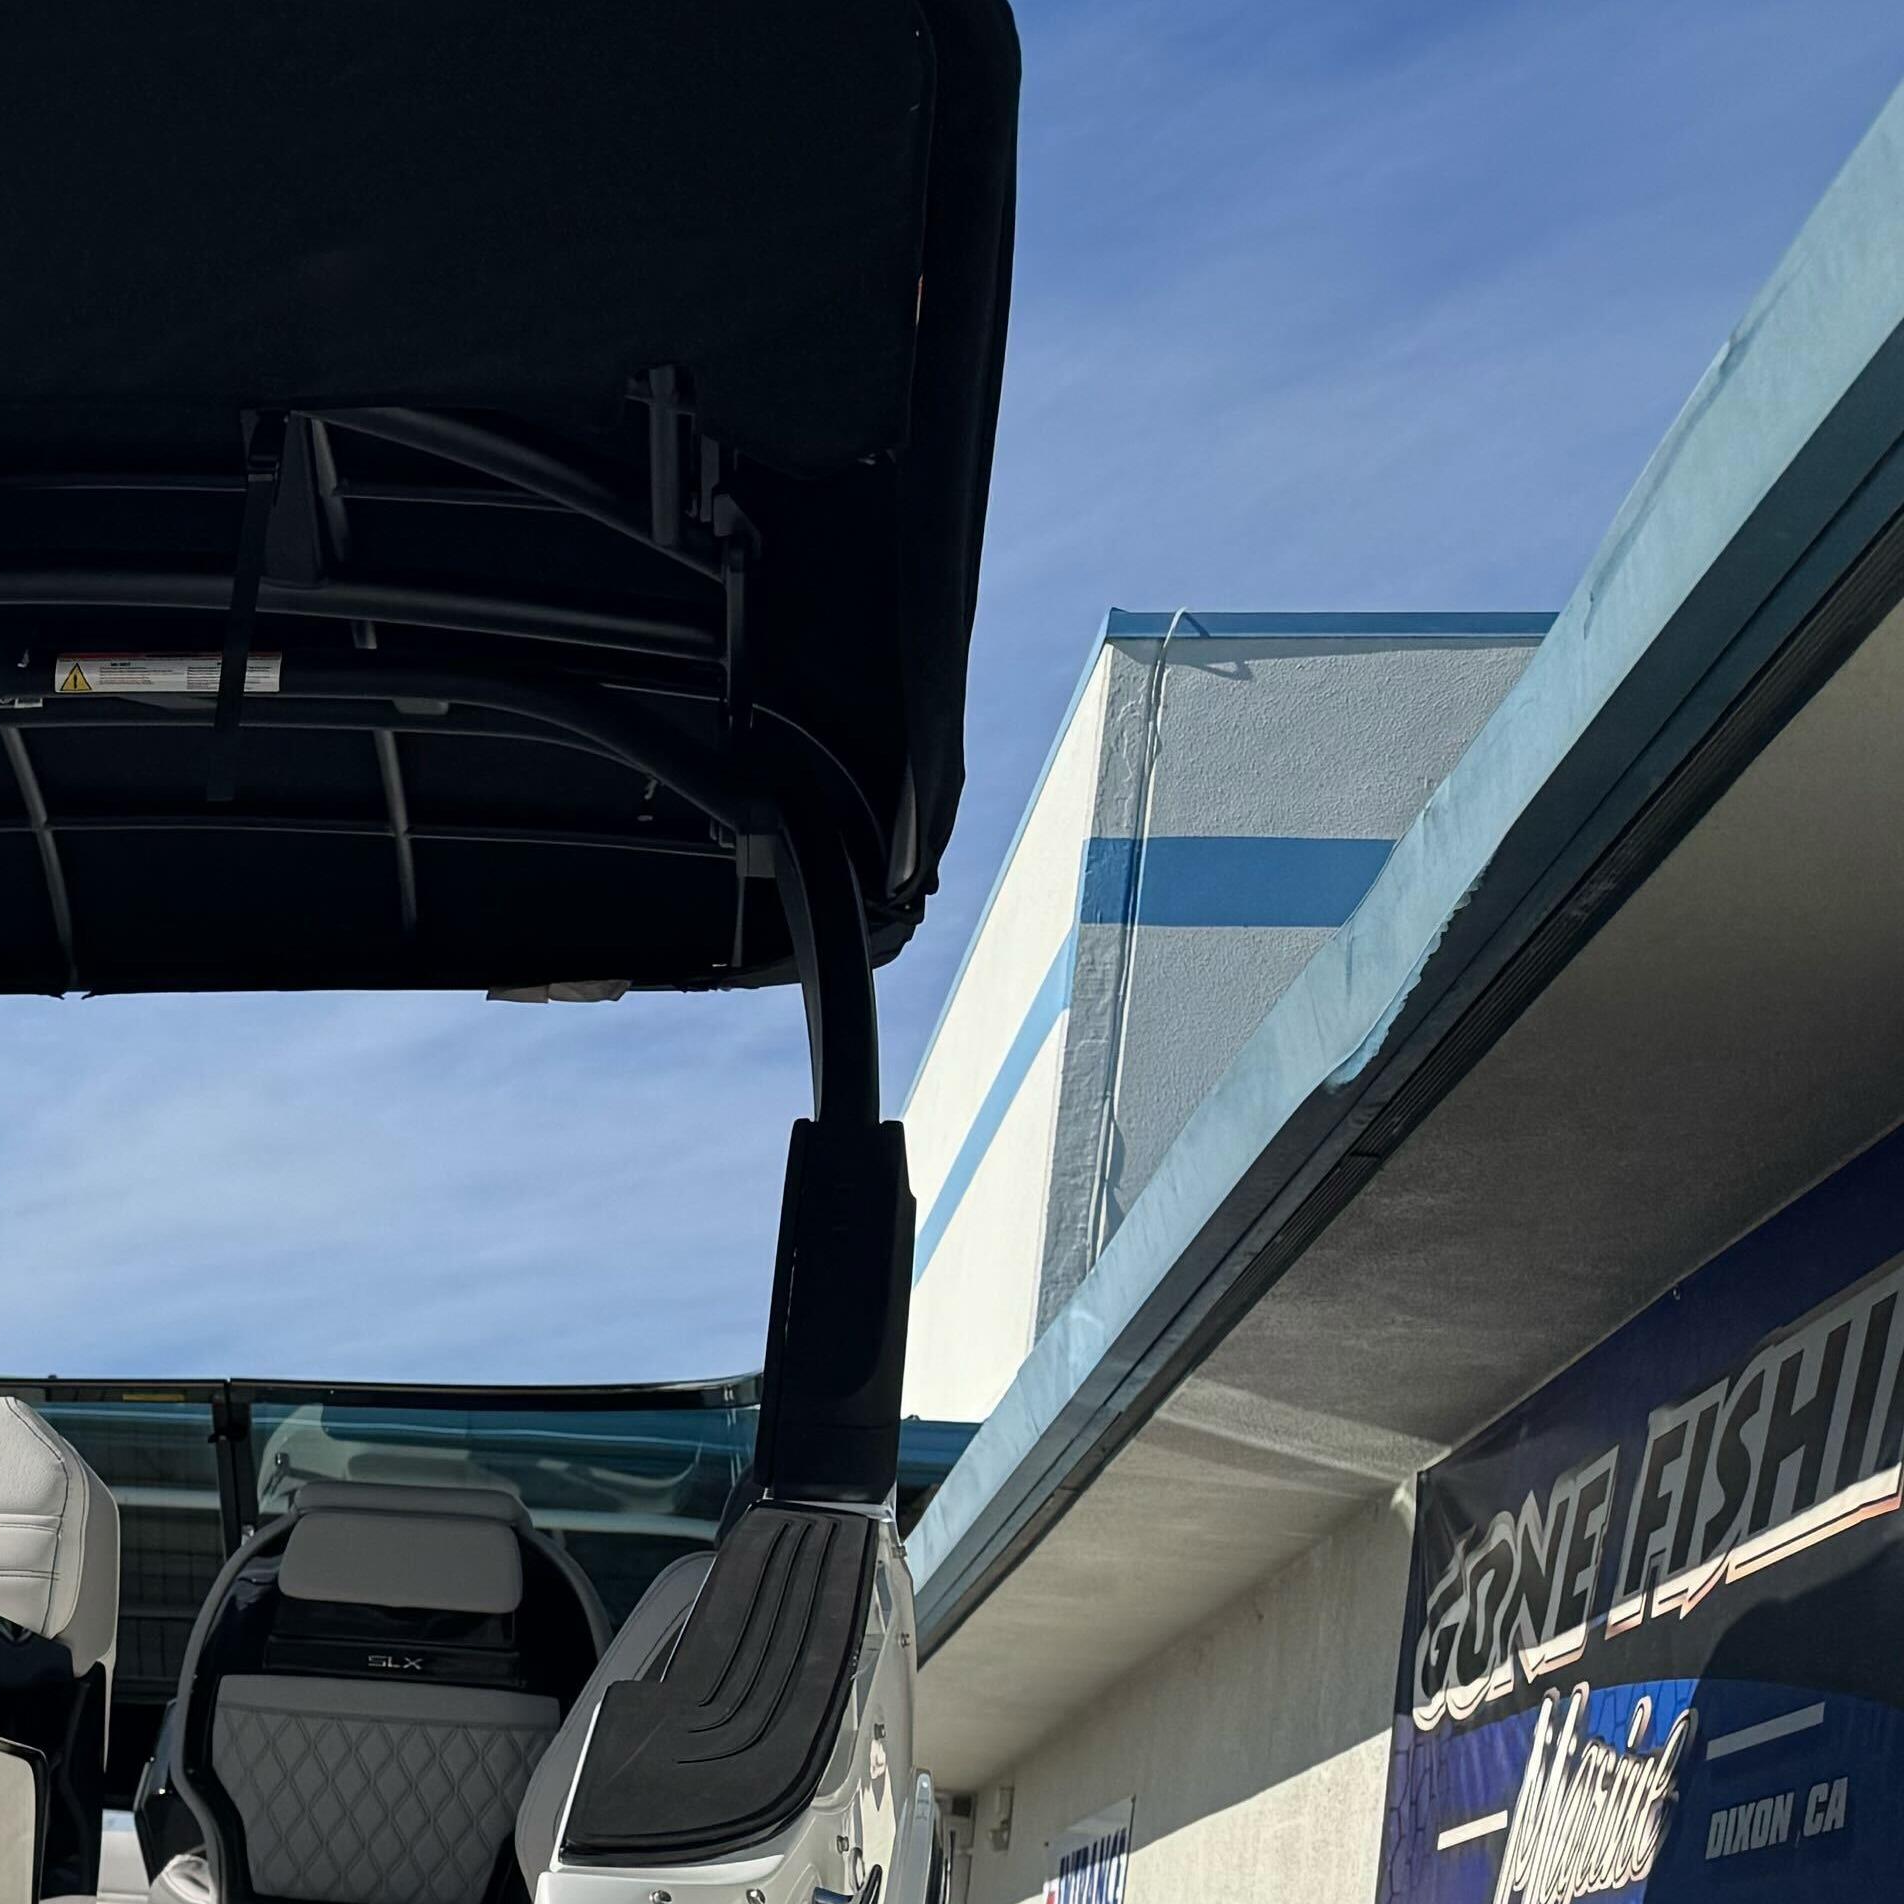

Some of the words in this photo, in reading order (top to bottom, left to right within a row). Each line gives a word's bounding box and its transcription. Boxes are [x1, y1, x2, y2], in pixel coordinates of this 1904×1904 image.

[1413, 1445, 1619, 1731] GONE
[368, 1655, 423, 1670] SLX
[1803, 1777, 1849, 1839] CA
